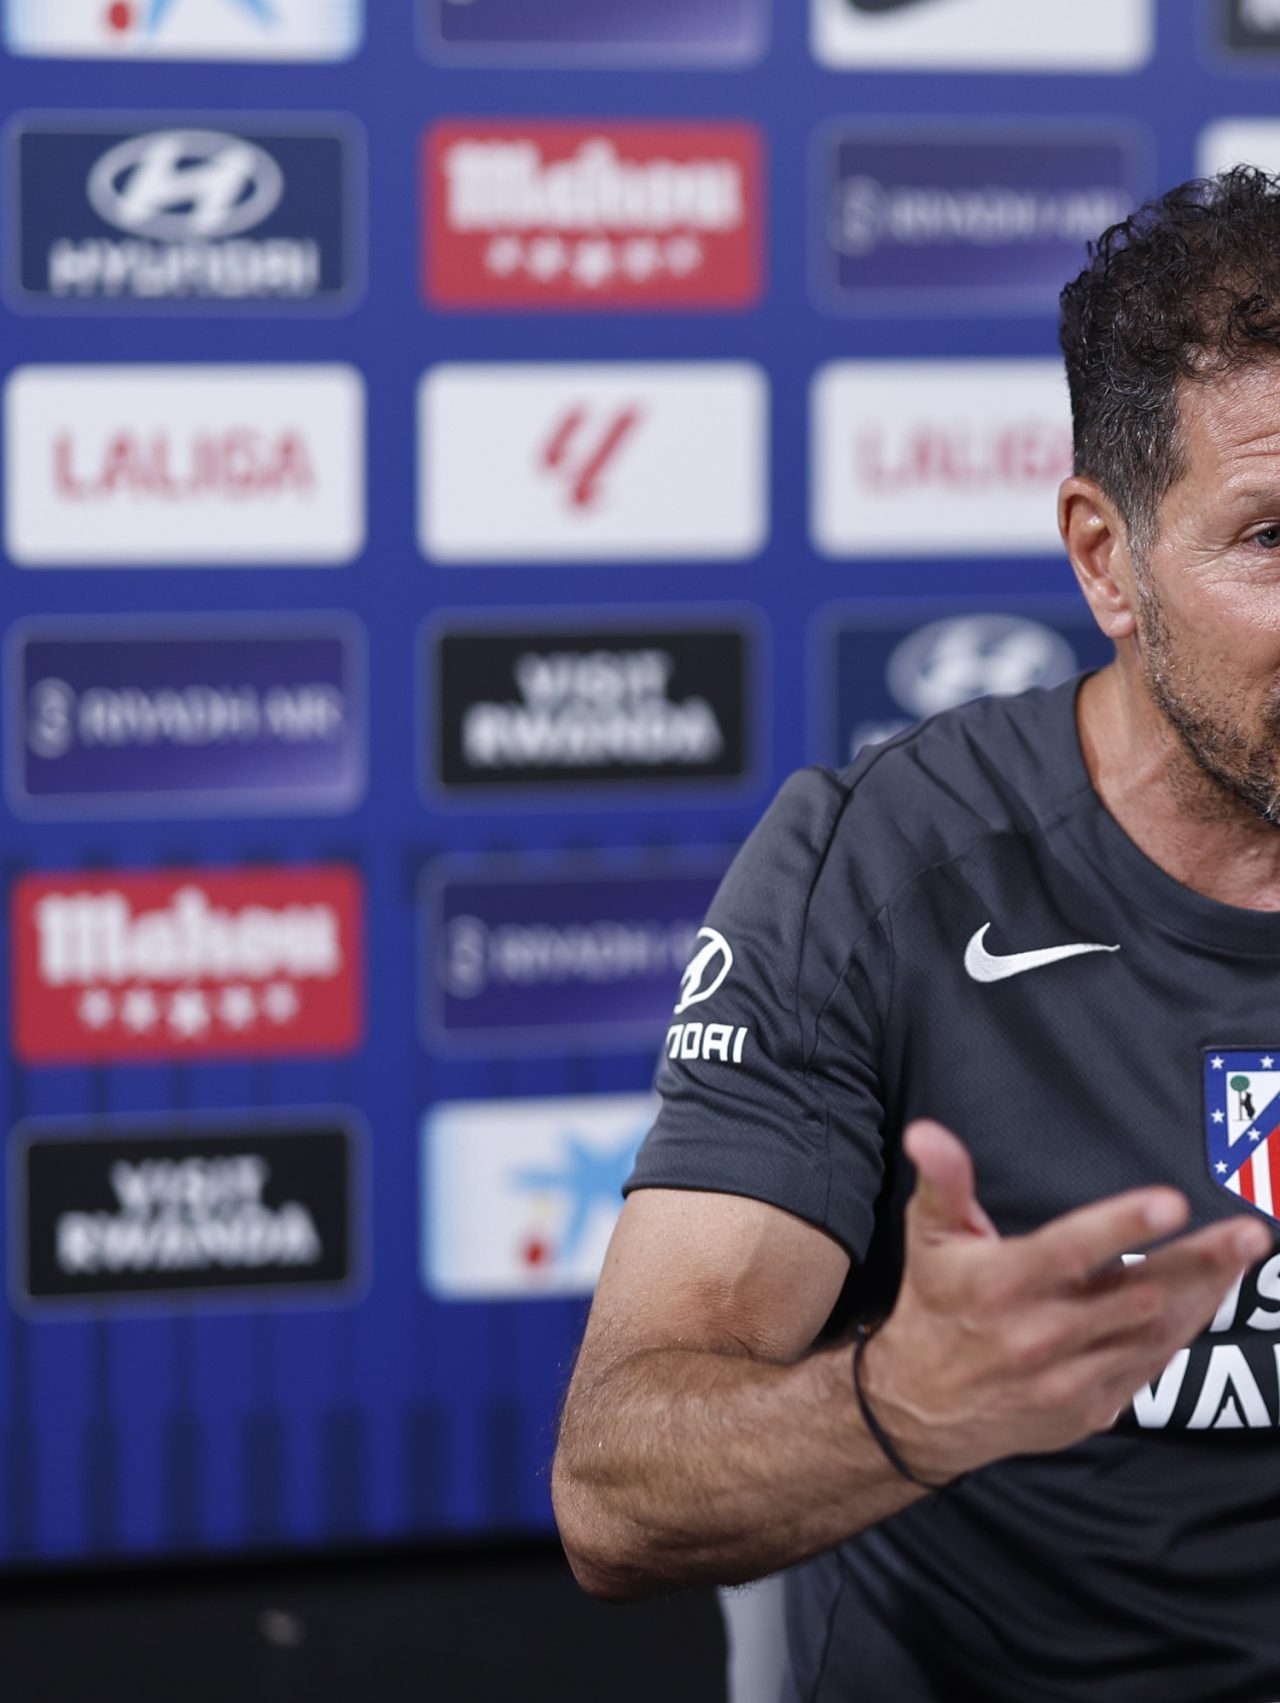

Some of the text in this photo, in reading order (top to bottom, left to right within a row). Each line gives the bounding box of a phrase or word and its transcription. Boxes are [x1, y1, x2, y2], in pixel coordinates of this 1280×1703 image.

[443, 138, 745, 233] Mahou
[53, 428, 314, 500] LALIGA
[37, 888, 340, 981] Mahou
[667, 1022, 748, 1063] NDAI
[57, 1200, 320, 1272] RWANDA
